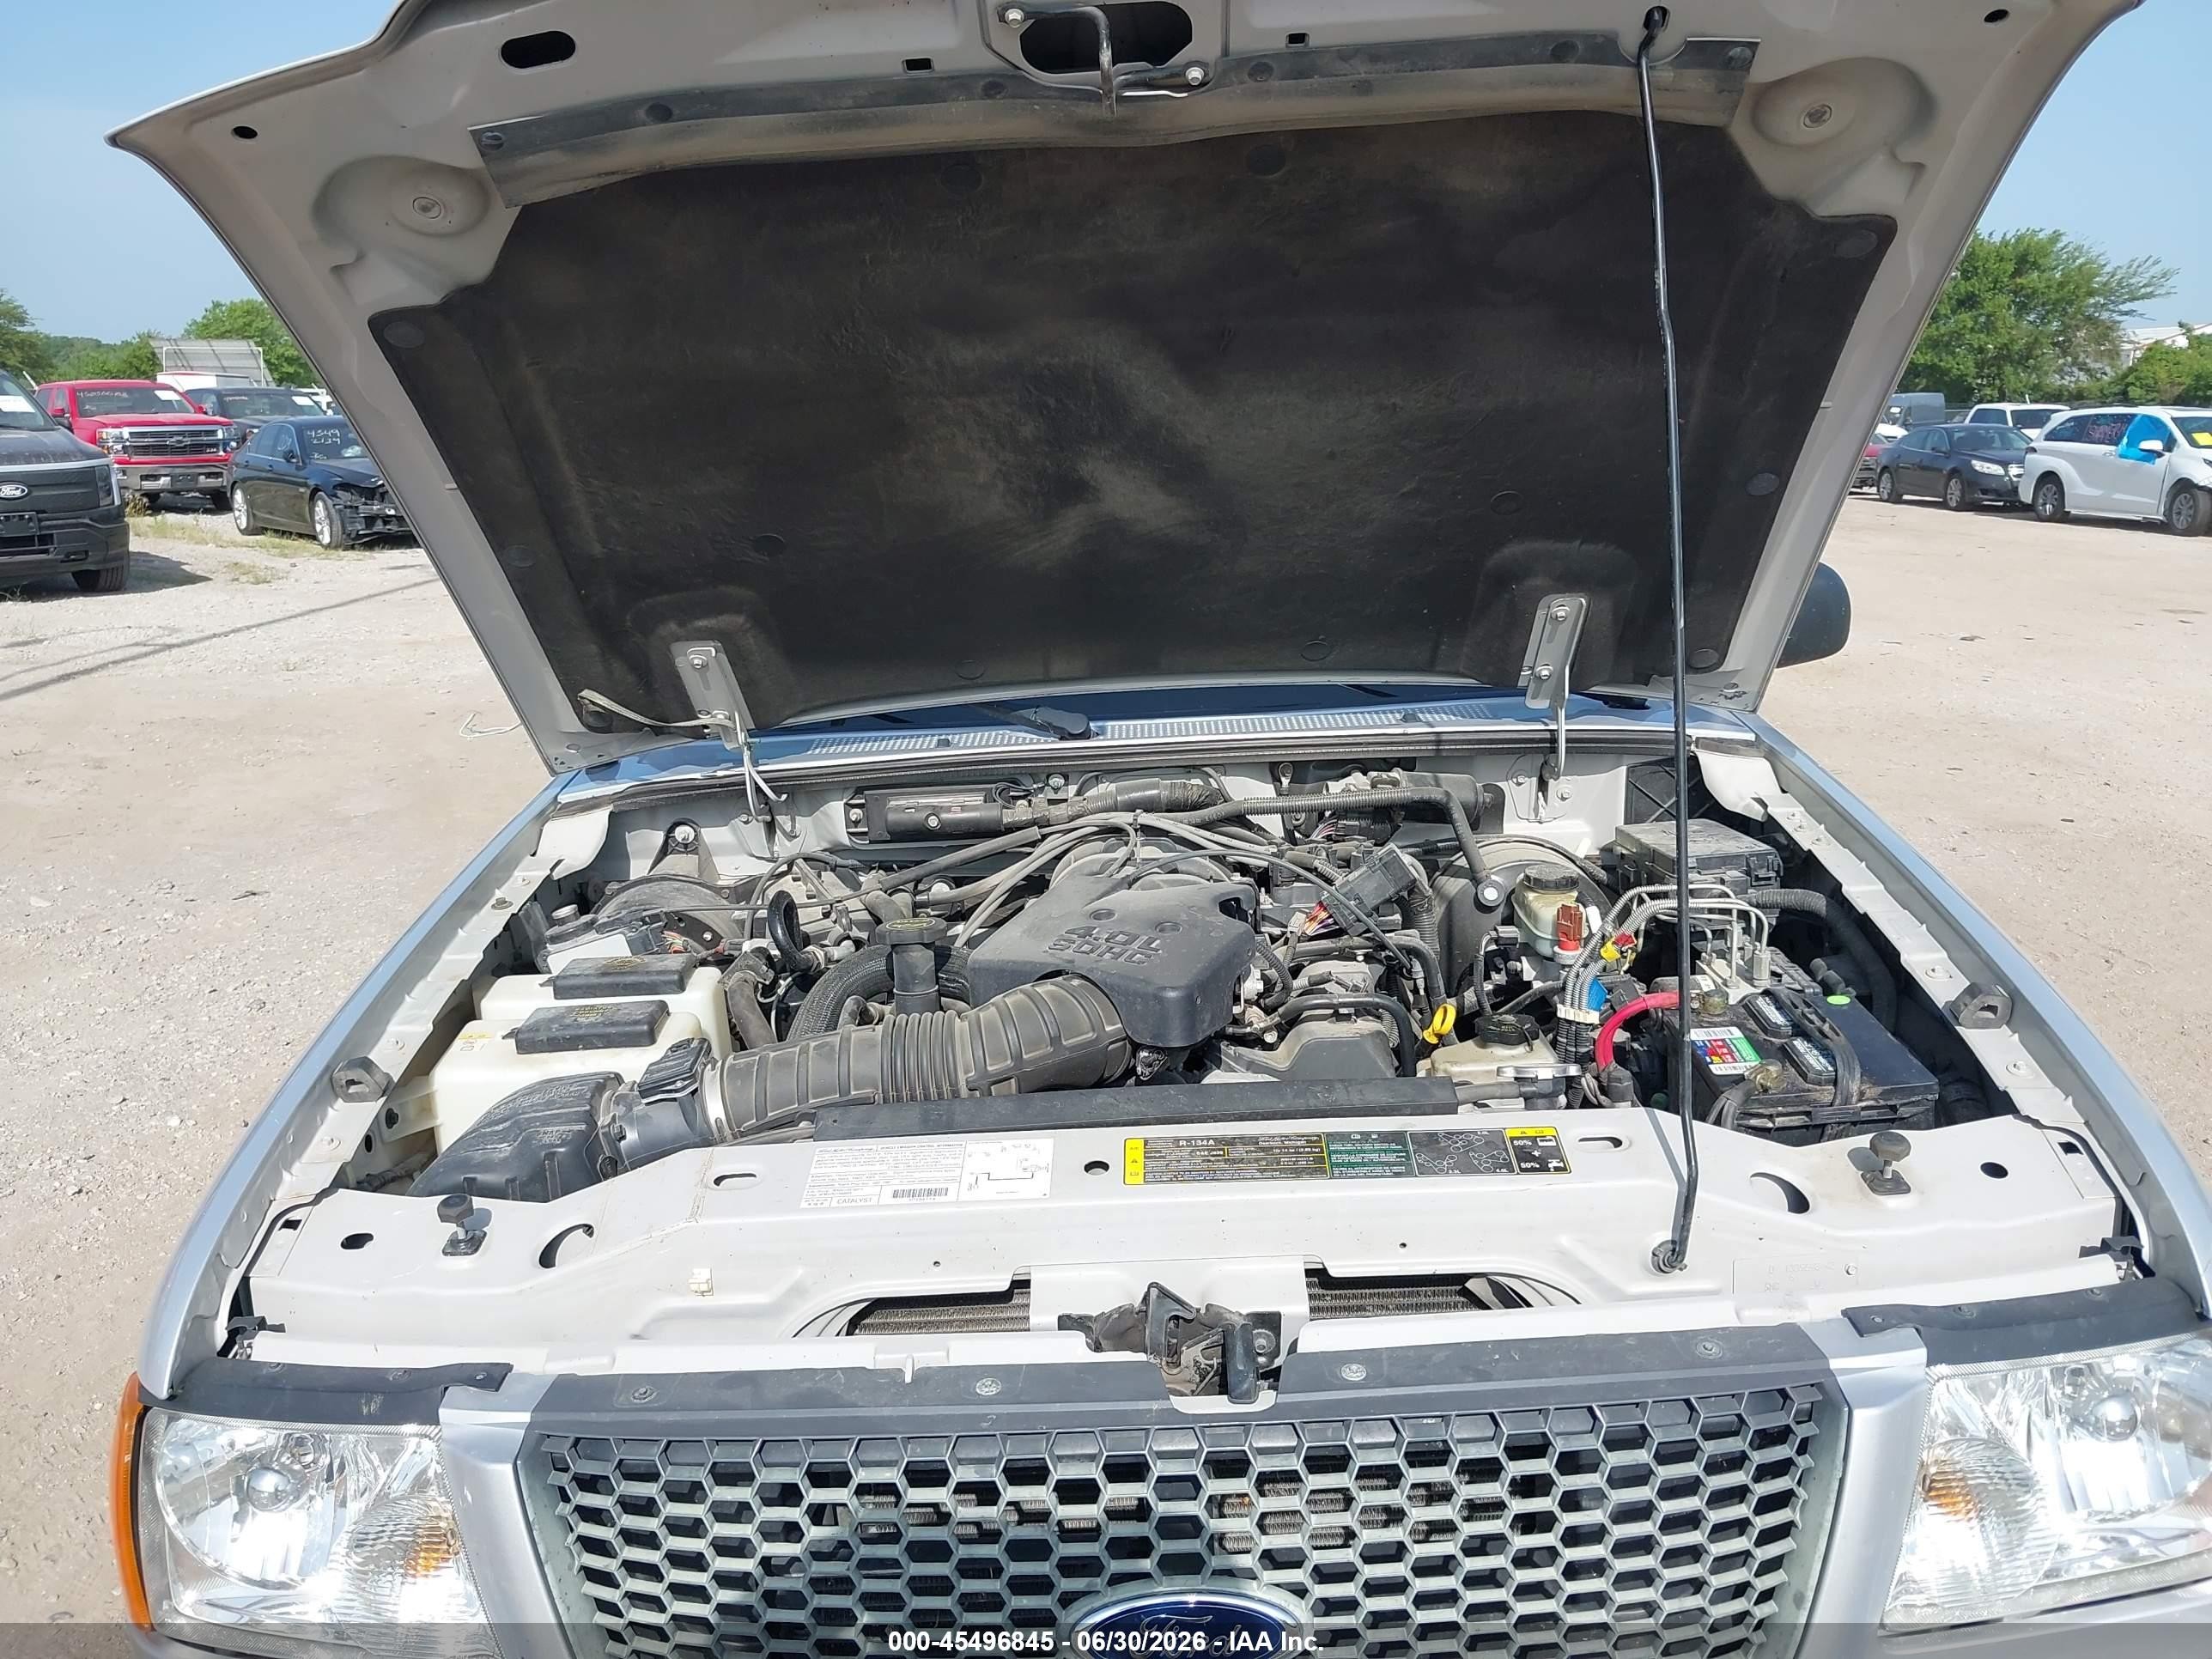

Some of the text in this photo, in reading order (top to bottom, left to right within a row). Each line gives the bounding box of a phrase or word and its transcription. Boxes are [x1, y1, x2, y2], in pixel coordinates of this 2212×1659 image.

[0, 486, 22, 496] Ford
[1047, 938, 1154, 966] SOHC
[1064, 926, 1162, 953] 4.0L
